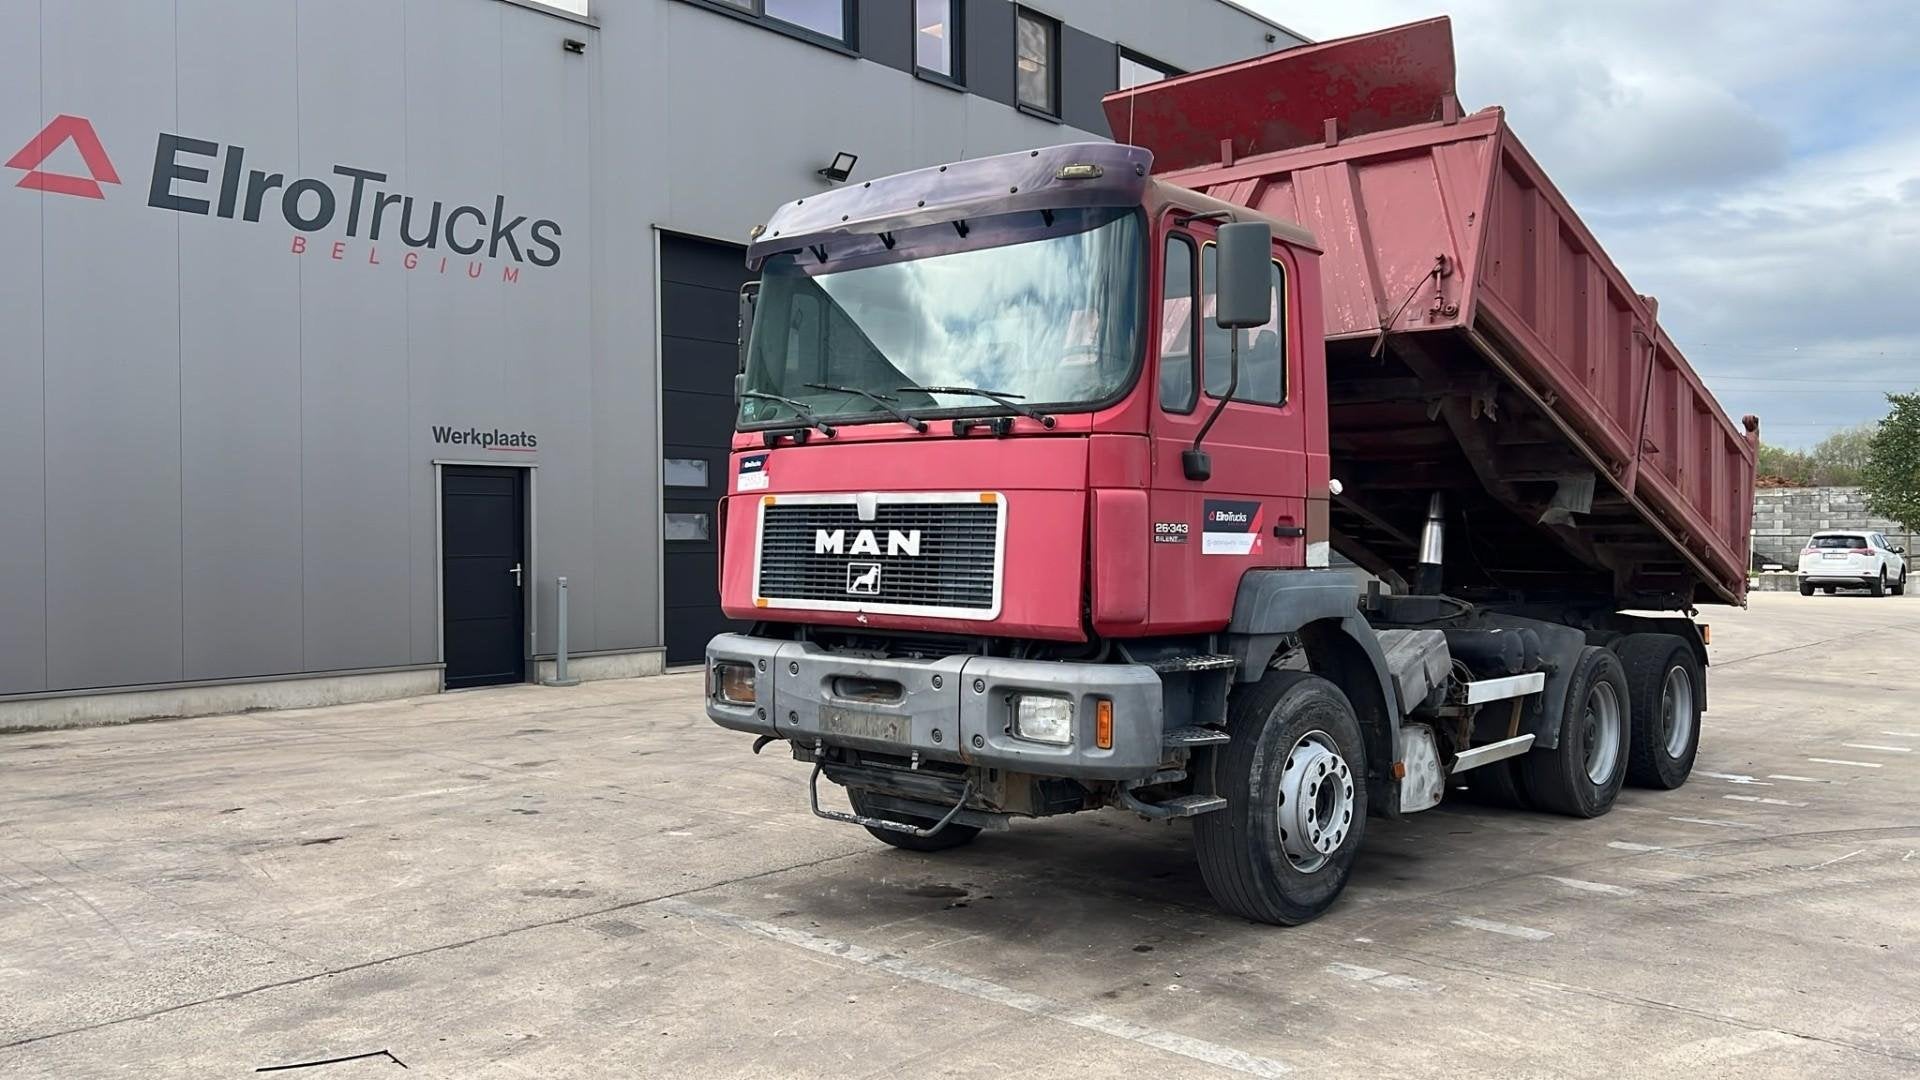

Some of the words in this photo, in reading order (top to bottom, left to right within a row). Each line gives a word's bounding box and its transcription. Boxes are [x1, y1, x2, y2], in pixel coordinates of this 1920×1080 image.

[147, 132, 563, 267] ElroTrucks
[291, 235, 521, 283] BELGIUM
[432, 425, 537, 449] Werkplaats
[815, 529, 921, 556] MAN
